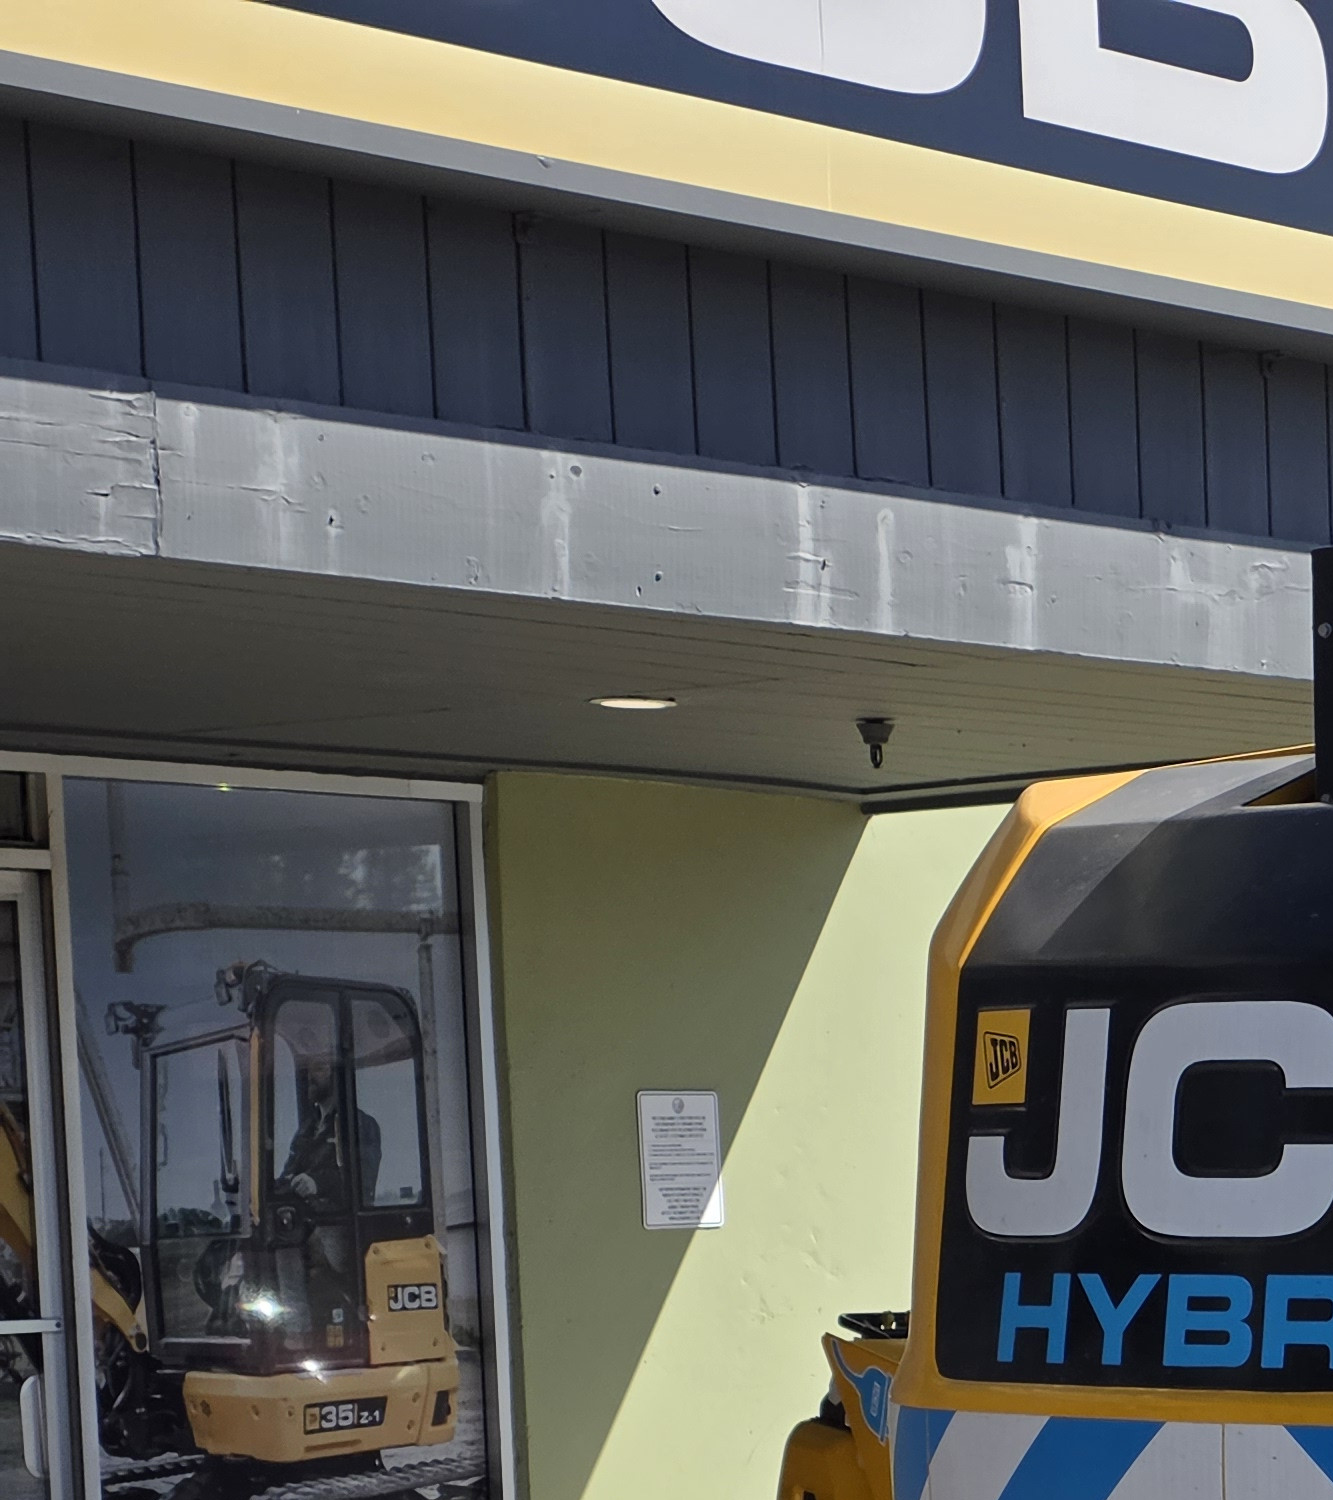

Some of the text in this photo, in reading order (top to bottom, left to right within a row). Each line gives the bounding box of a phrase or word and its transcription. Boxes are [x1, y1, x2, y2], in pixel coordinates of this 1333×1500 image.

[989, 1038, 1018, 1081] JCB
[389, 1286, 437, 1310] JCB
[321, 1404, 353, 1428] 35
